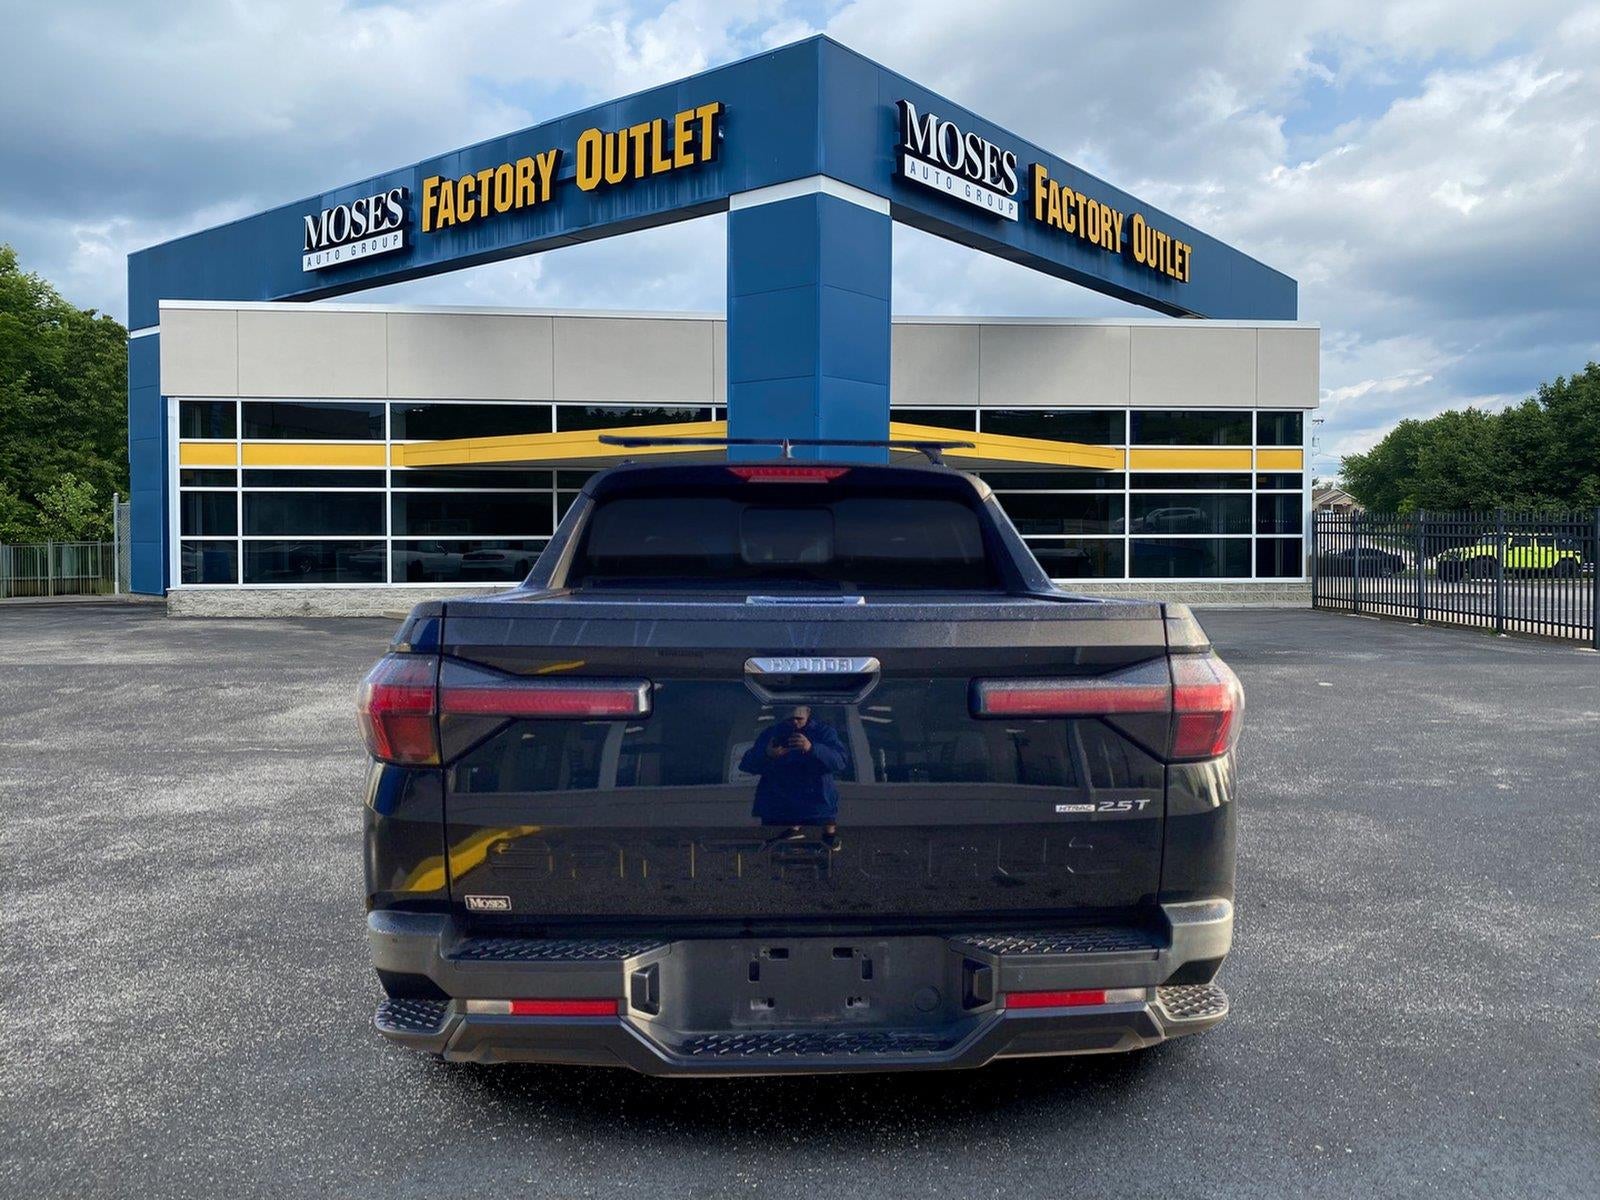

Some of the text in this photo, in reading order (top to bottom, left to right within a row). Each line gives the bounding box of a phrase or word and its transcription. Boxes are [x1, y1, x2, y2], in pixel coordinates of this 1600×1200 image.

[422, 101, 720, 233] FACTORY OUTLET
[904, 99, 1018, 196] MOSES
[302, 187, 404, 252] MOSES
[909, 160, 1015, 214] AUTO GROUP
[306, 235, 400, 267] AUTO GROUP
[1033, 162, 1192, 283] FACTORY OUTLET
[469, 898, 507, 910] MOSES
